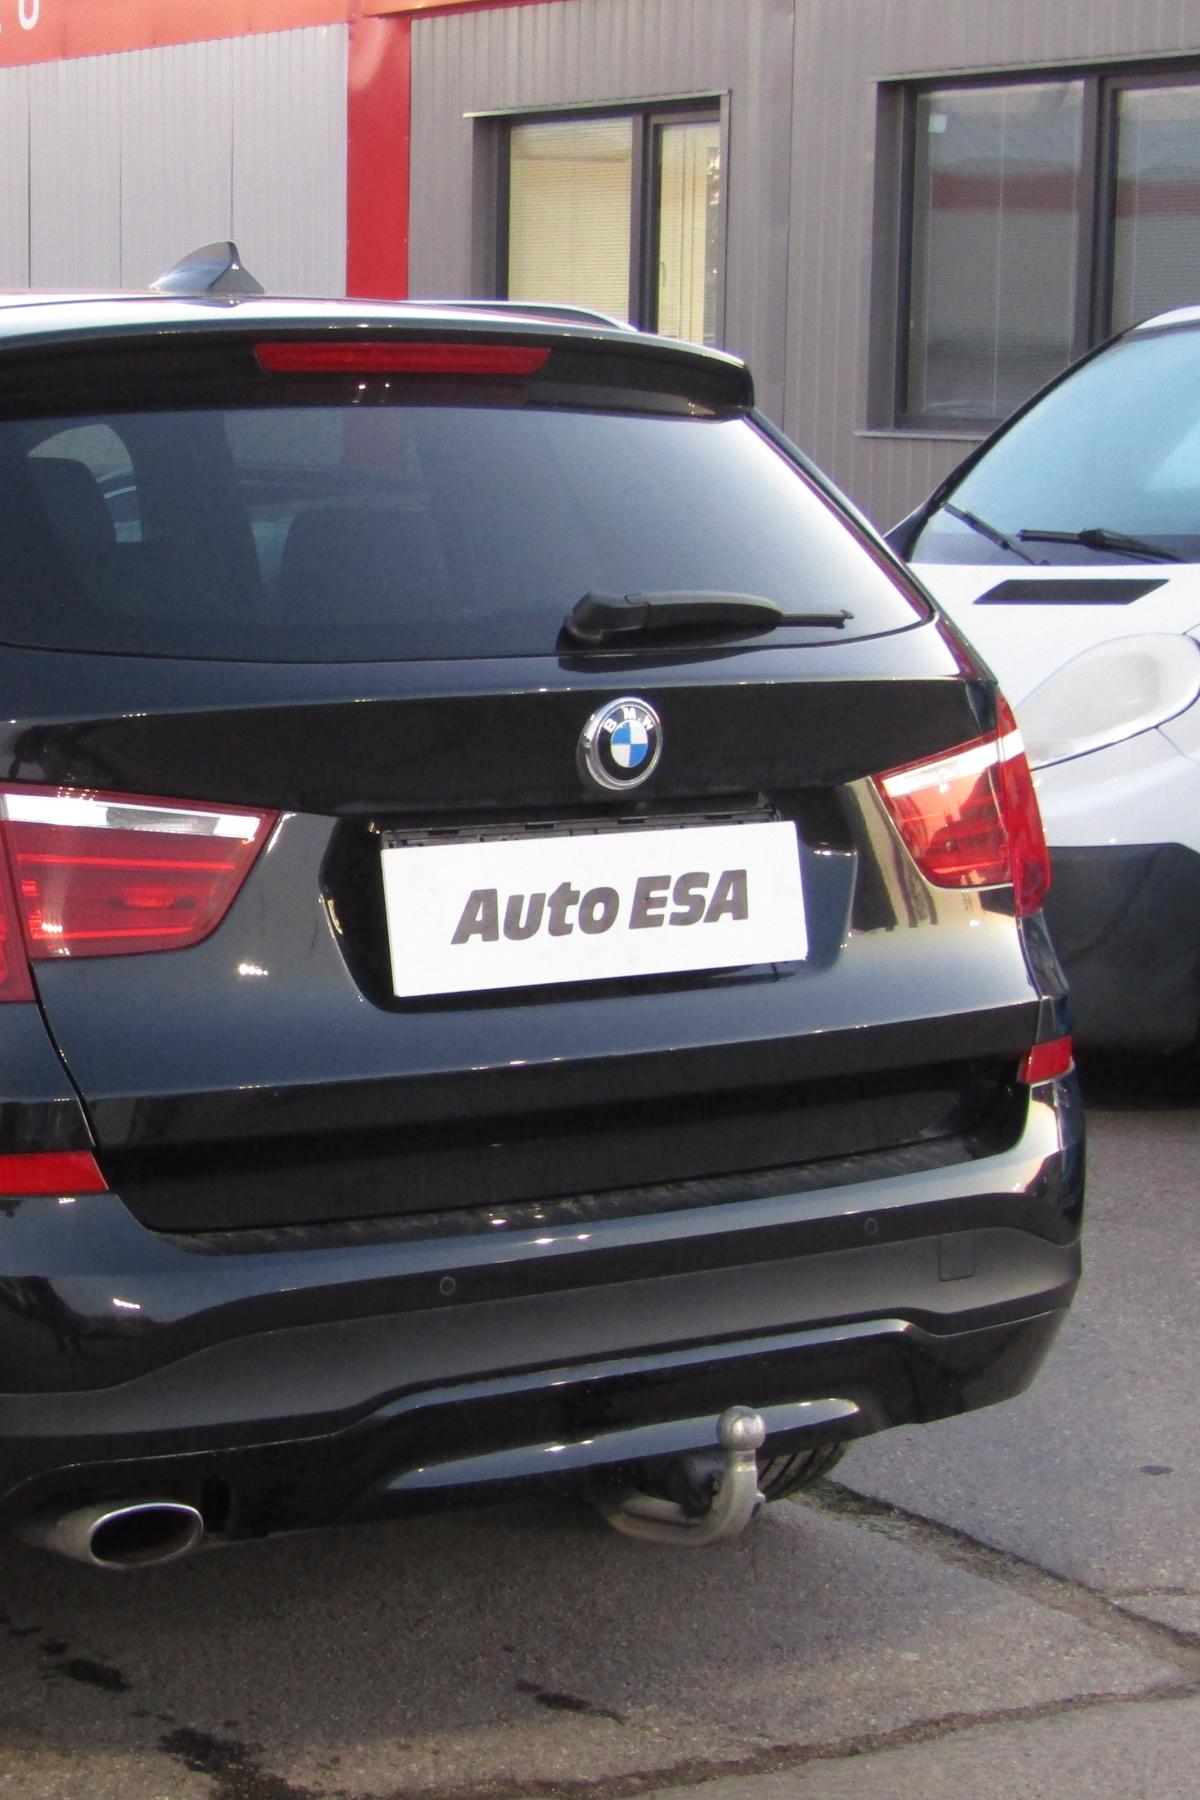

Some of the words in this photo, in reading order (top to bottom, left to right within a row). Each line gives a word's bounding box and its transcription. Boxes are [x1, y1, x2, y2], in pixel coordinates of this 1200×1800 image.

[603, 706, 654, 733] BMW
[451, 881, 620, 944] Auto
[629, 869, 749, 930] ESA
